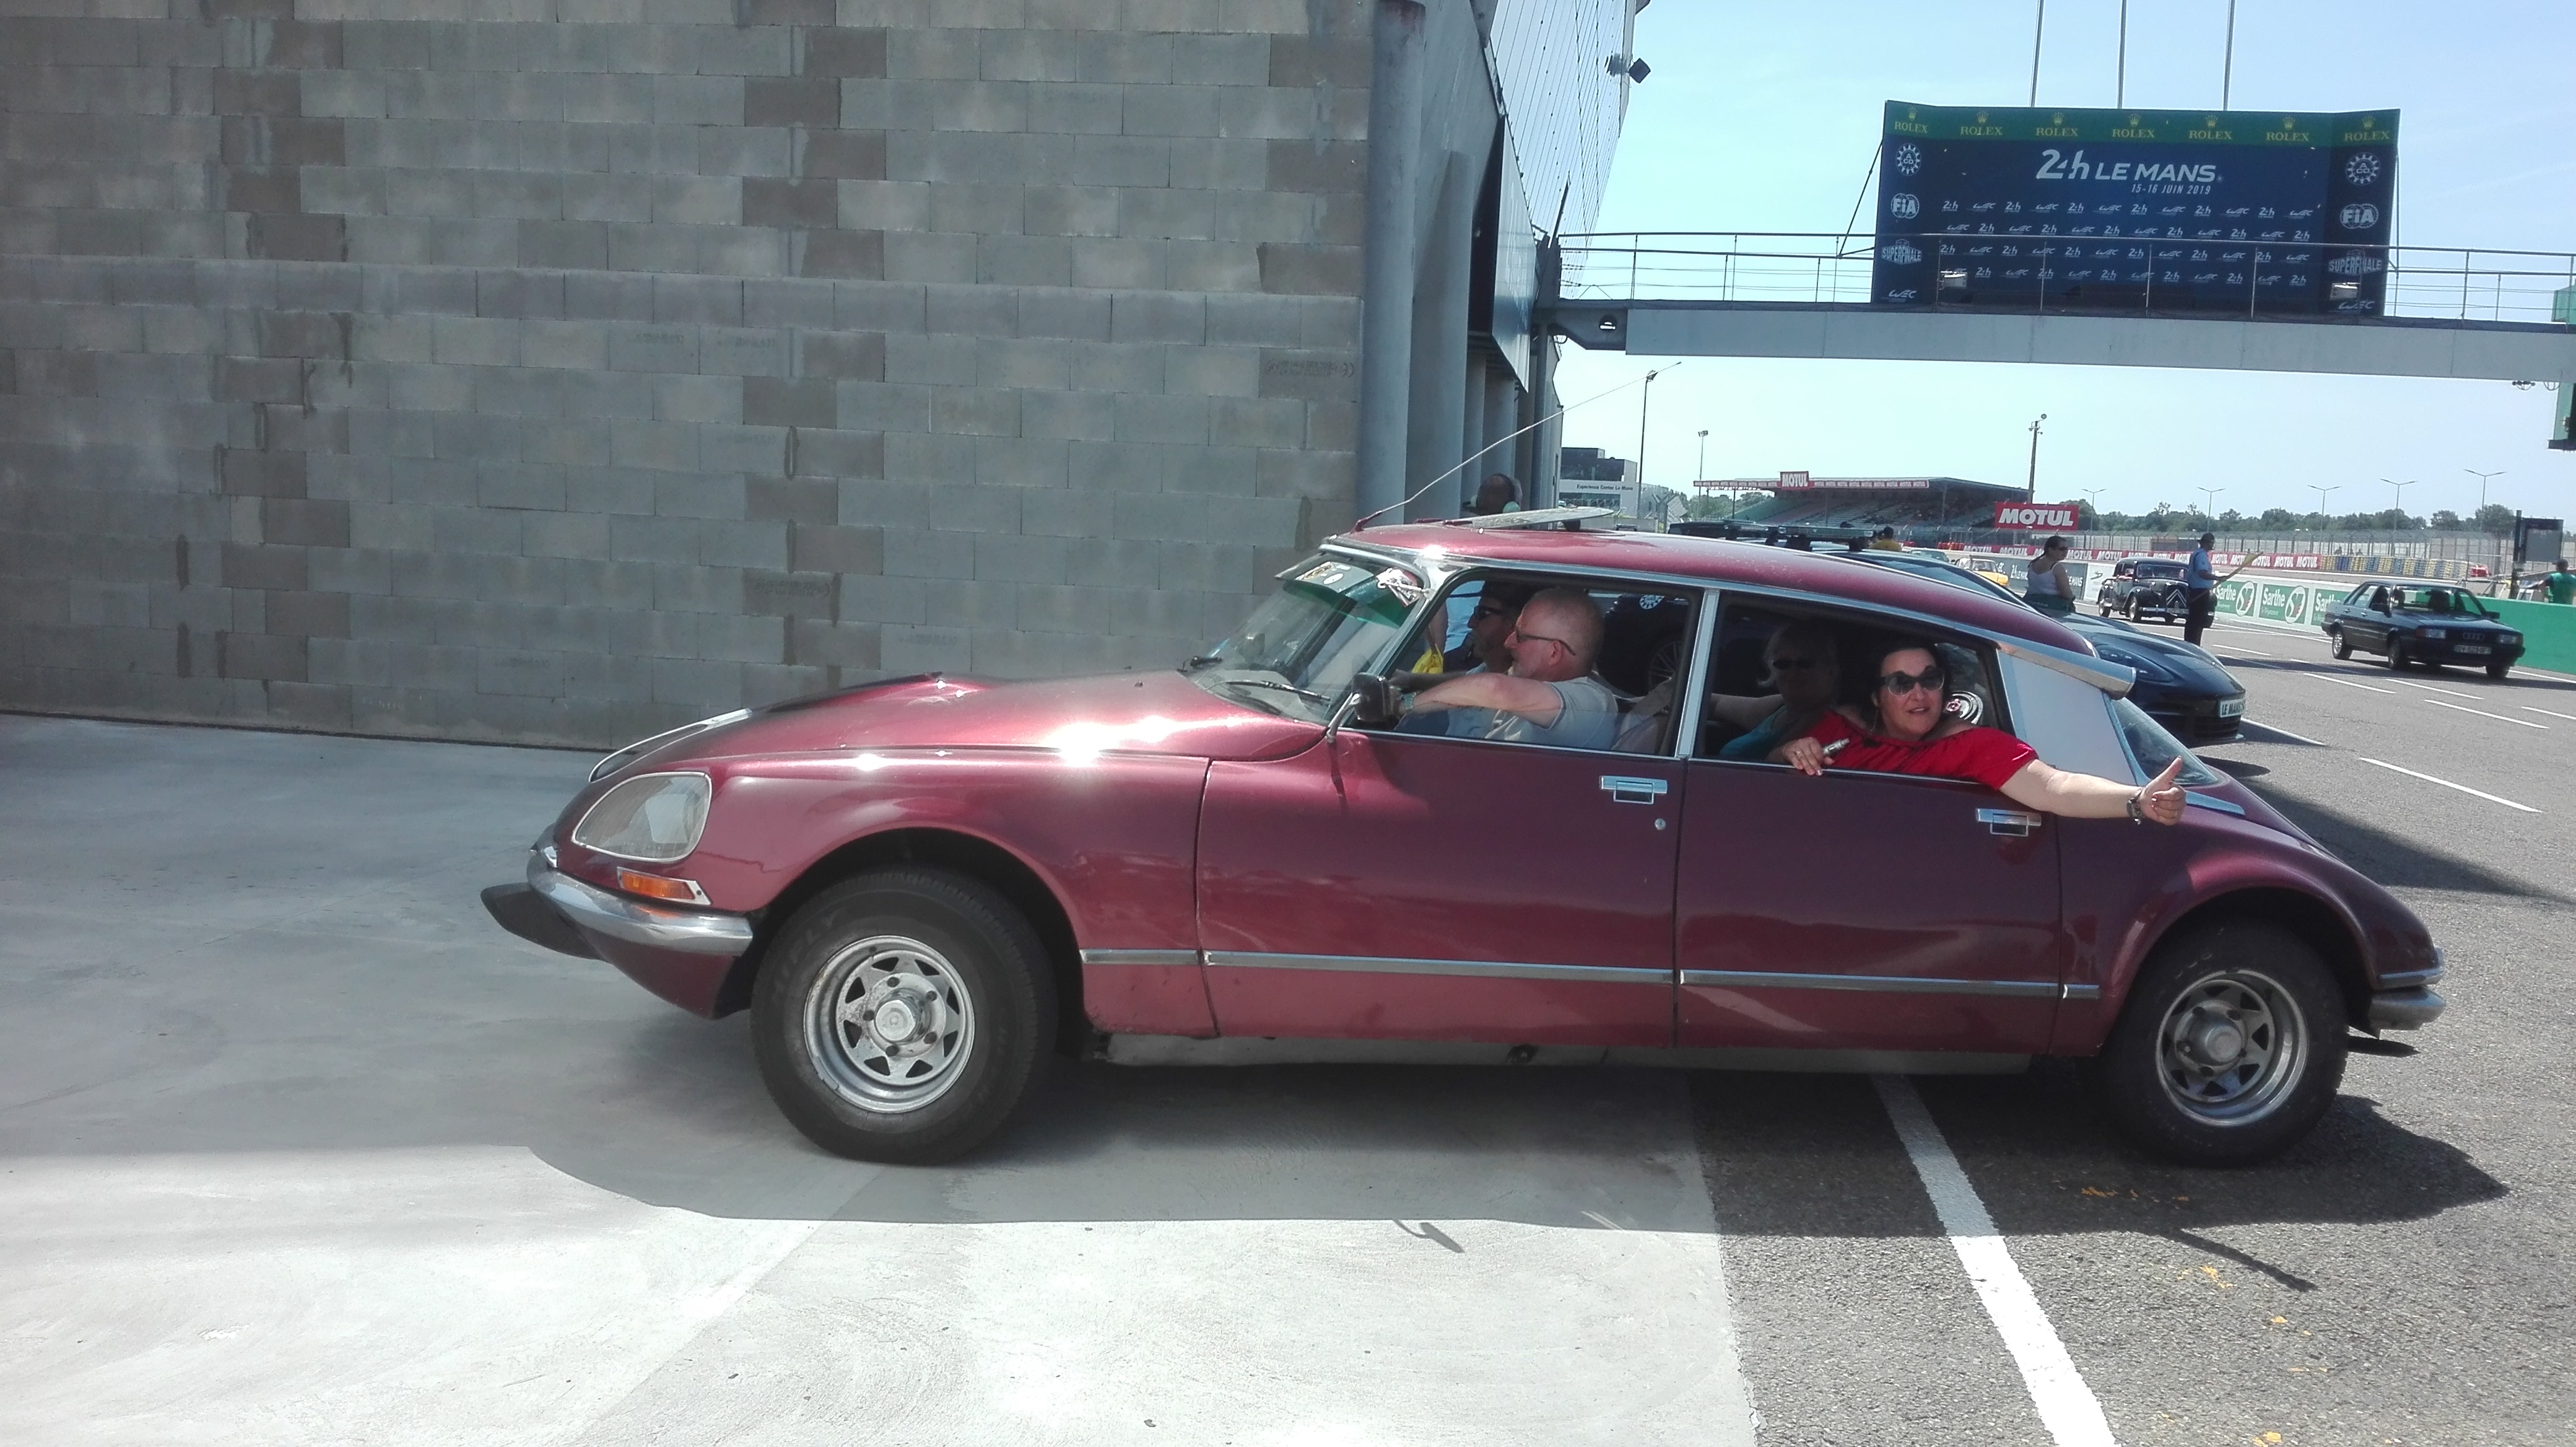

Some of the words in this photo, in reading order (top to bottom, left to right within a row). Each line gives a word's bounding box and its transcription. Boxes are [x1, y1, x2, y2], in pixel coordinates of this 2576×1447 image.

[1894, 121, 1928, 134] ROLEX
[1960, 126, 2003, 136] ROLEX
[2035, 128, 2078, 137] ROLEX
[2112, 129, 2155, 138] ROLEX
[2188, 130, 2232, 140] ROLEX
[2266, 132, 2309, 142] ROLEX
[2344, 131, 2390, 141] ROLEX
[2095, 162, 2131, 180] LE
[2134, 164, 2217, 182] MANS
[2161, 185, 2183, 194] JUIN
[2187, 185, 2211, 195] 2019
[1782, 473, 1808, 487] MOTUL
[1998, 508, 2074, 527] MOTUL
[1964, 545, 1992, 553] MOTUL
[1999, 546, 2028, 556] MOTUL
[2066, 549, 2092, 560] MOTUL
[2097, 550, 2123, 561] MOTUL
[2211, 554, 2228, 564] MOTUL
[2274, 556, 2294, 568] MOTUL
[2296, 556, 2318, 569] MOTUL
[2216, 584, 2237, 601] Sarthe
[2263, 587, 2286, 607] Sarthe
